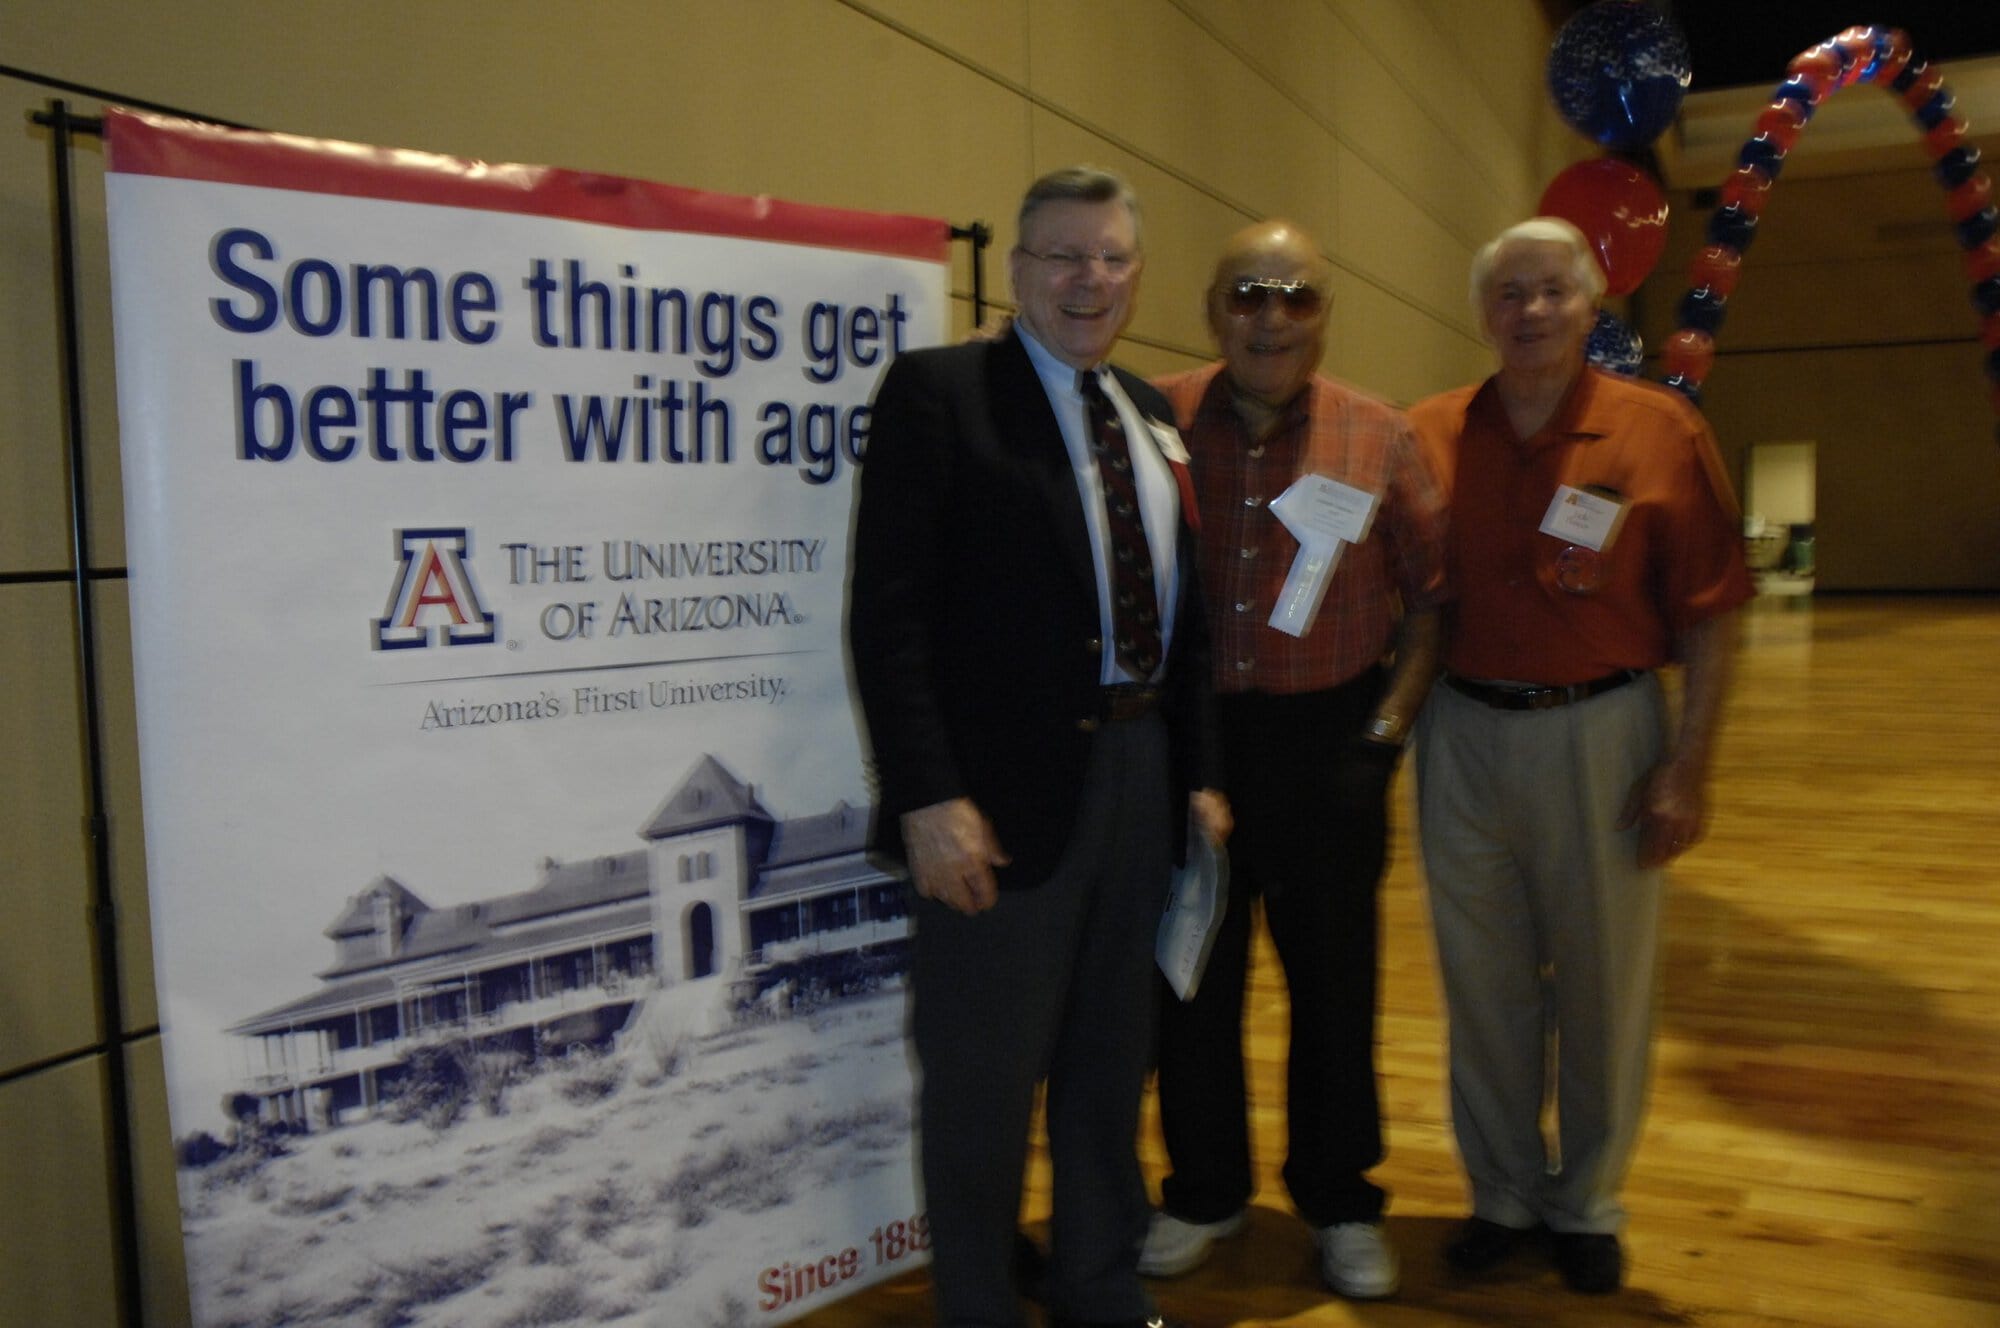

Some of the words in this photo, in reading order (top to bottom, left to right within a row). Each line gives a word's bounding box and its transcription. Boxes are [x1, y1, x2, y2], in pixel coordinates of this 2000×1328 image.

[209, 227, 501, 345] Some
[522, 258, 781, 378] things
[802, 292, 908, 384] get
[232, 359, 533, 463] better
[553, 374, 735, 464] with
[754, 401, 874, 485] age
[371, 527, 496, 651] A
[499, 541, 587, 585] THE
[602, 538, 824, 582] UNIVERSITY
[540, 601, 598, 641] OF
[419, 691, 561, 731] Arizona's
[573, 686, 638, 715] First
[757, 1246, 858, 1312] Since
